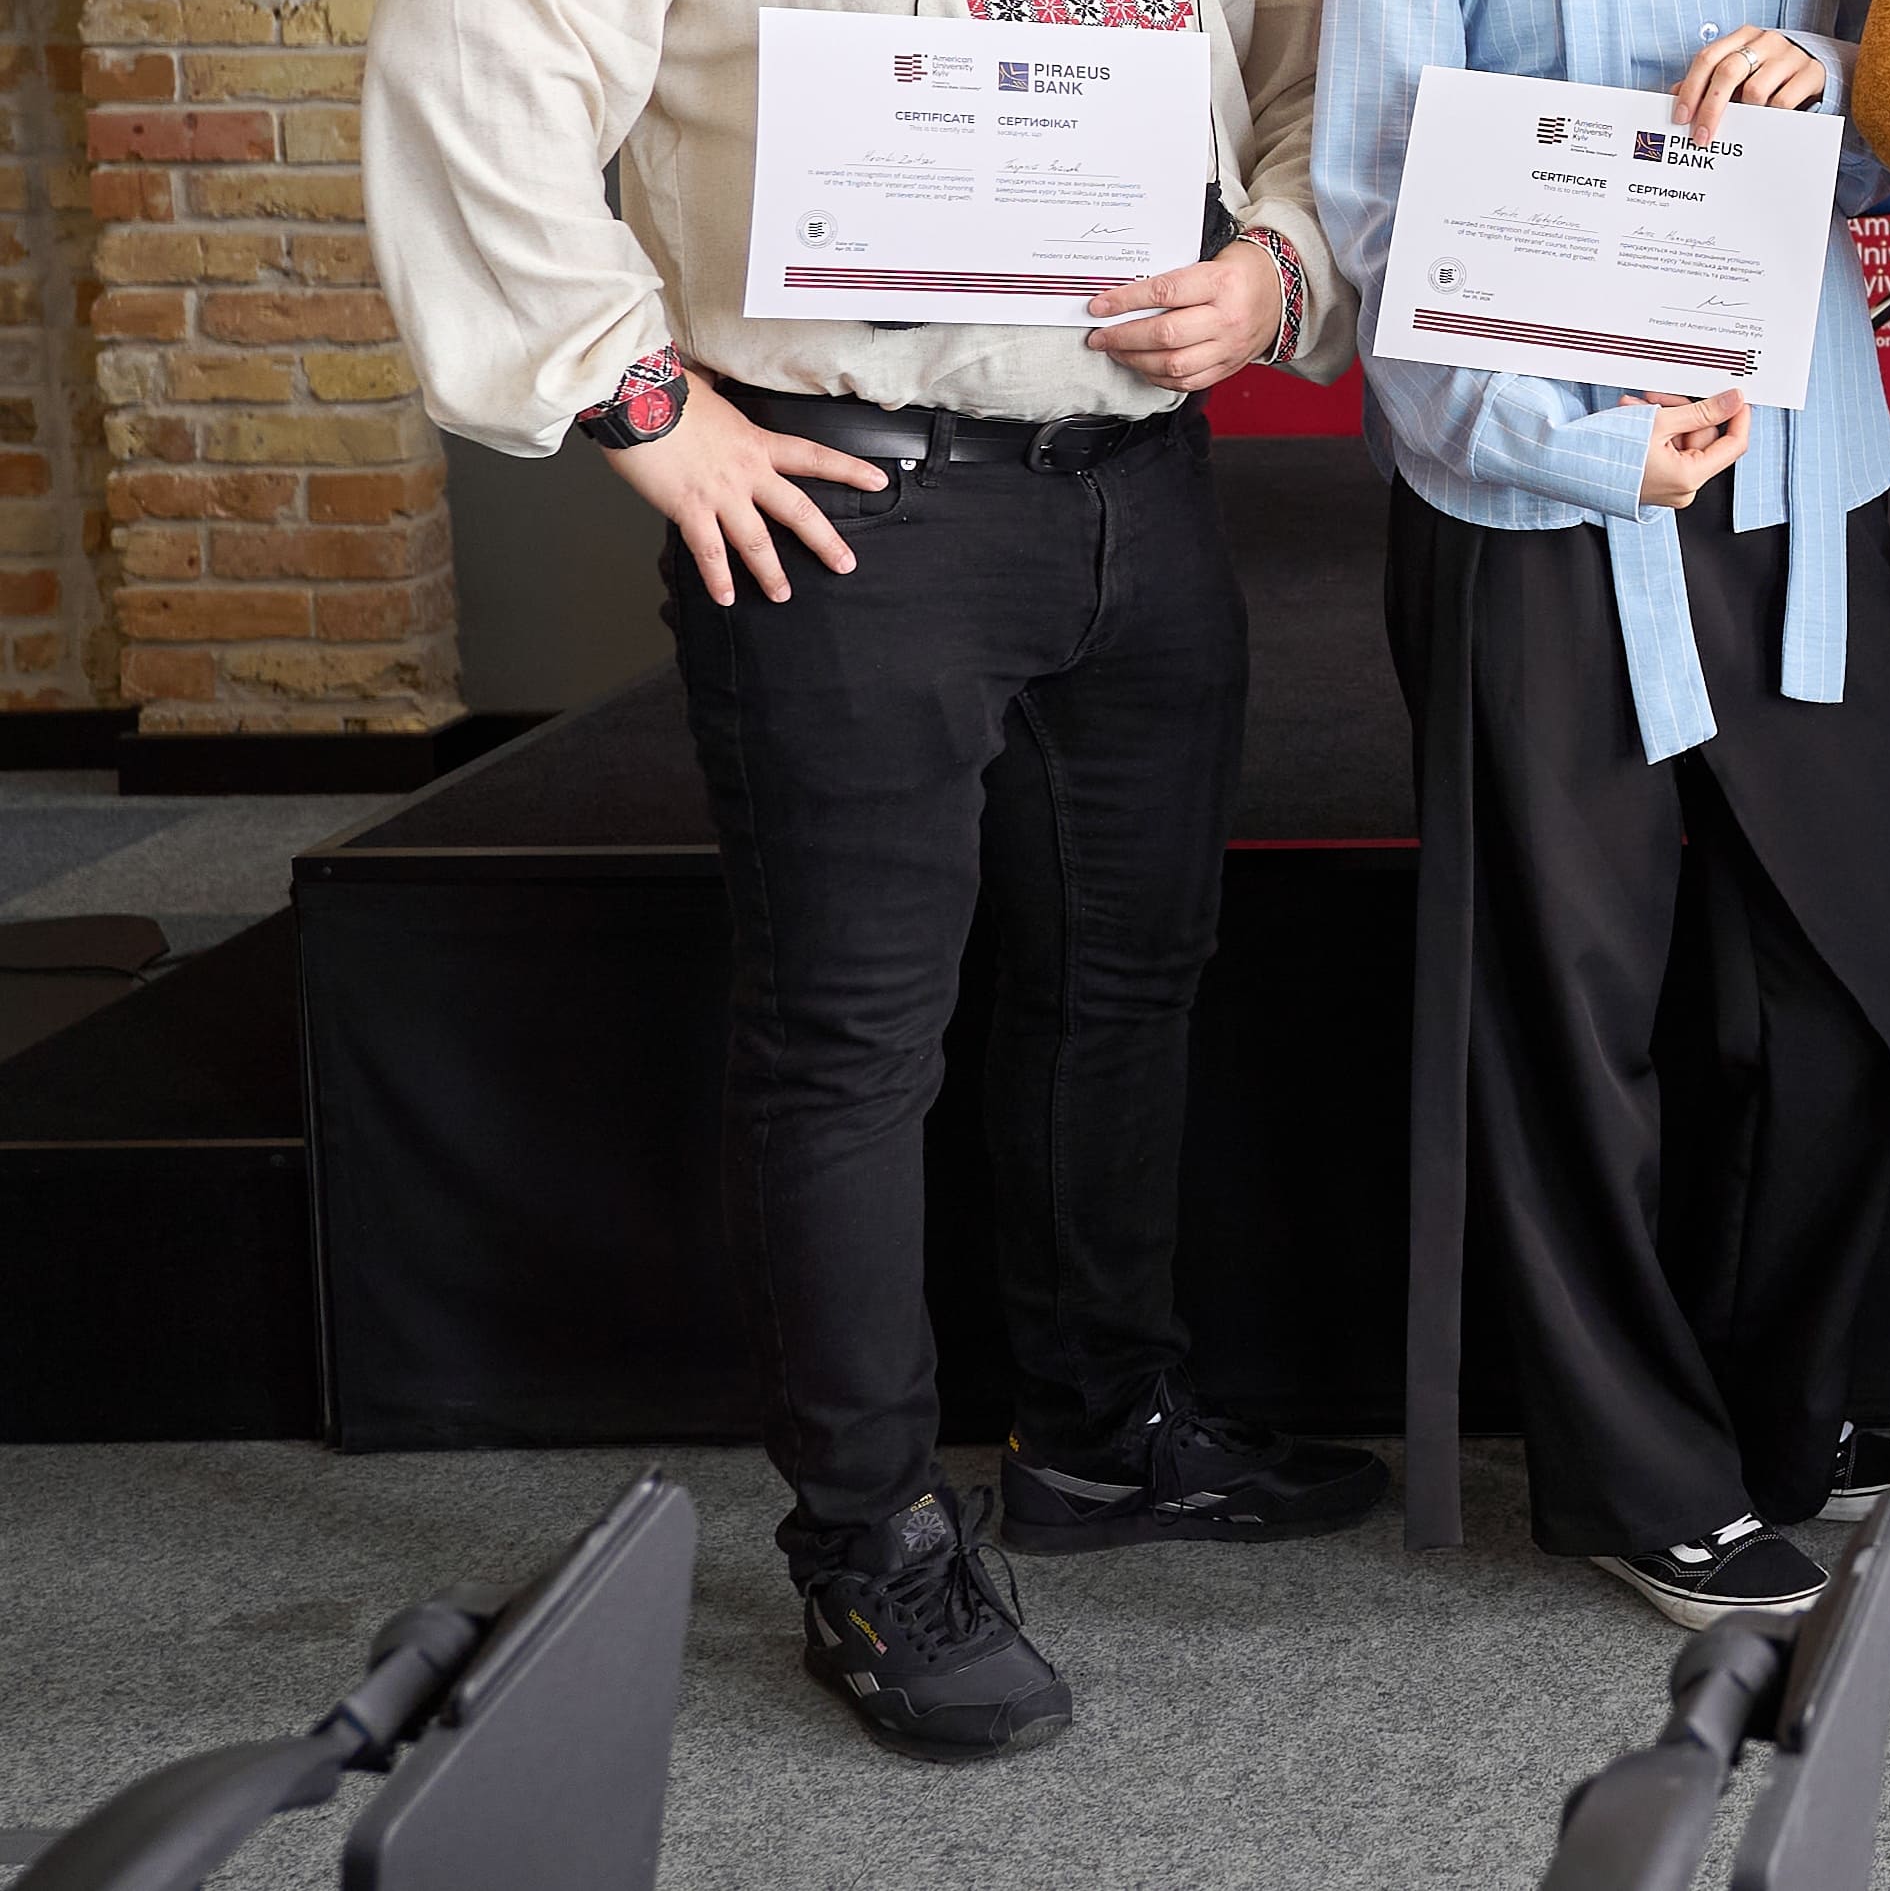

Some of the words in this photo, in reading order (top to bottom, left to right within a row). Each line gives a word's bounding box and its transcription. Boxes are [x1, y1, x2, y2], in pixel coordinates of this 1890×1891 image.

[1034, 63, 1111, 80] PIRAEUS
[1034, 81, 1083, 95] BANK
[895, 111, 975, 124] CERTIFICATE
[998, 117, 1078, 129] СЕРТИФІКАТ
[1574, 119, 1613, 131] American
[1573, 126, 1613, 139] University
[1667, 152, 1715, 170] BANK
[1531, 170, 1607, 189] CERTIFICATE
[1628, 183, 1705, 202] СЕРТИФІКАТ
[1649, 317, 1678, 327] President
[1688, 322, 1717, 332] American
[1719, 326, 1749, 337] University
